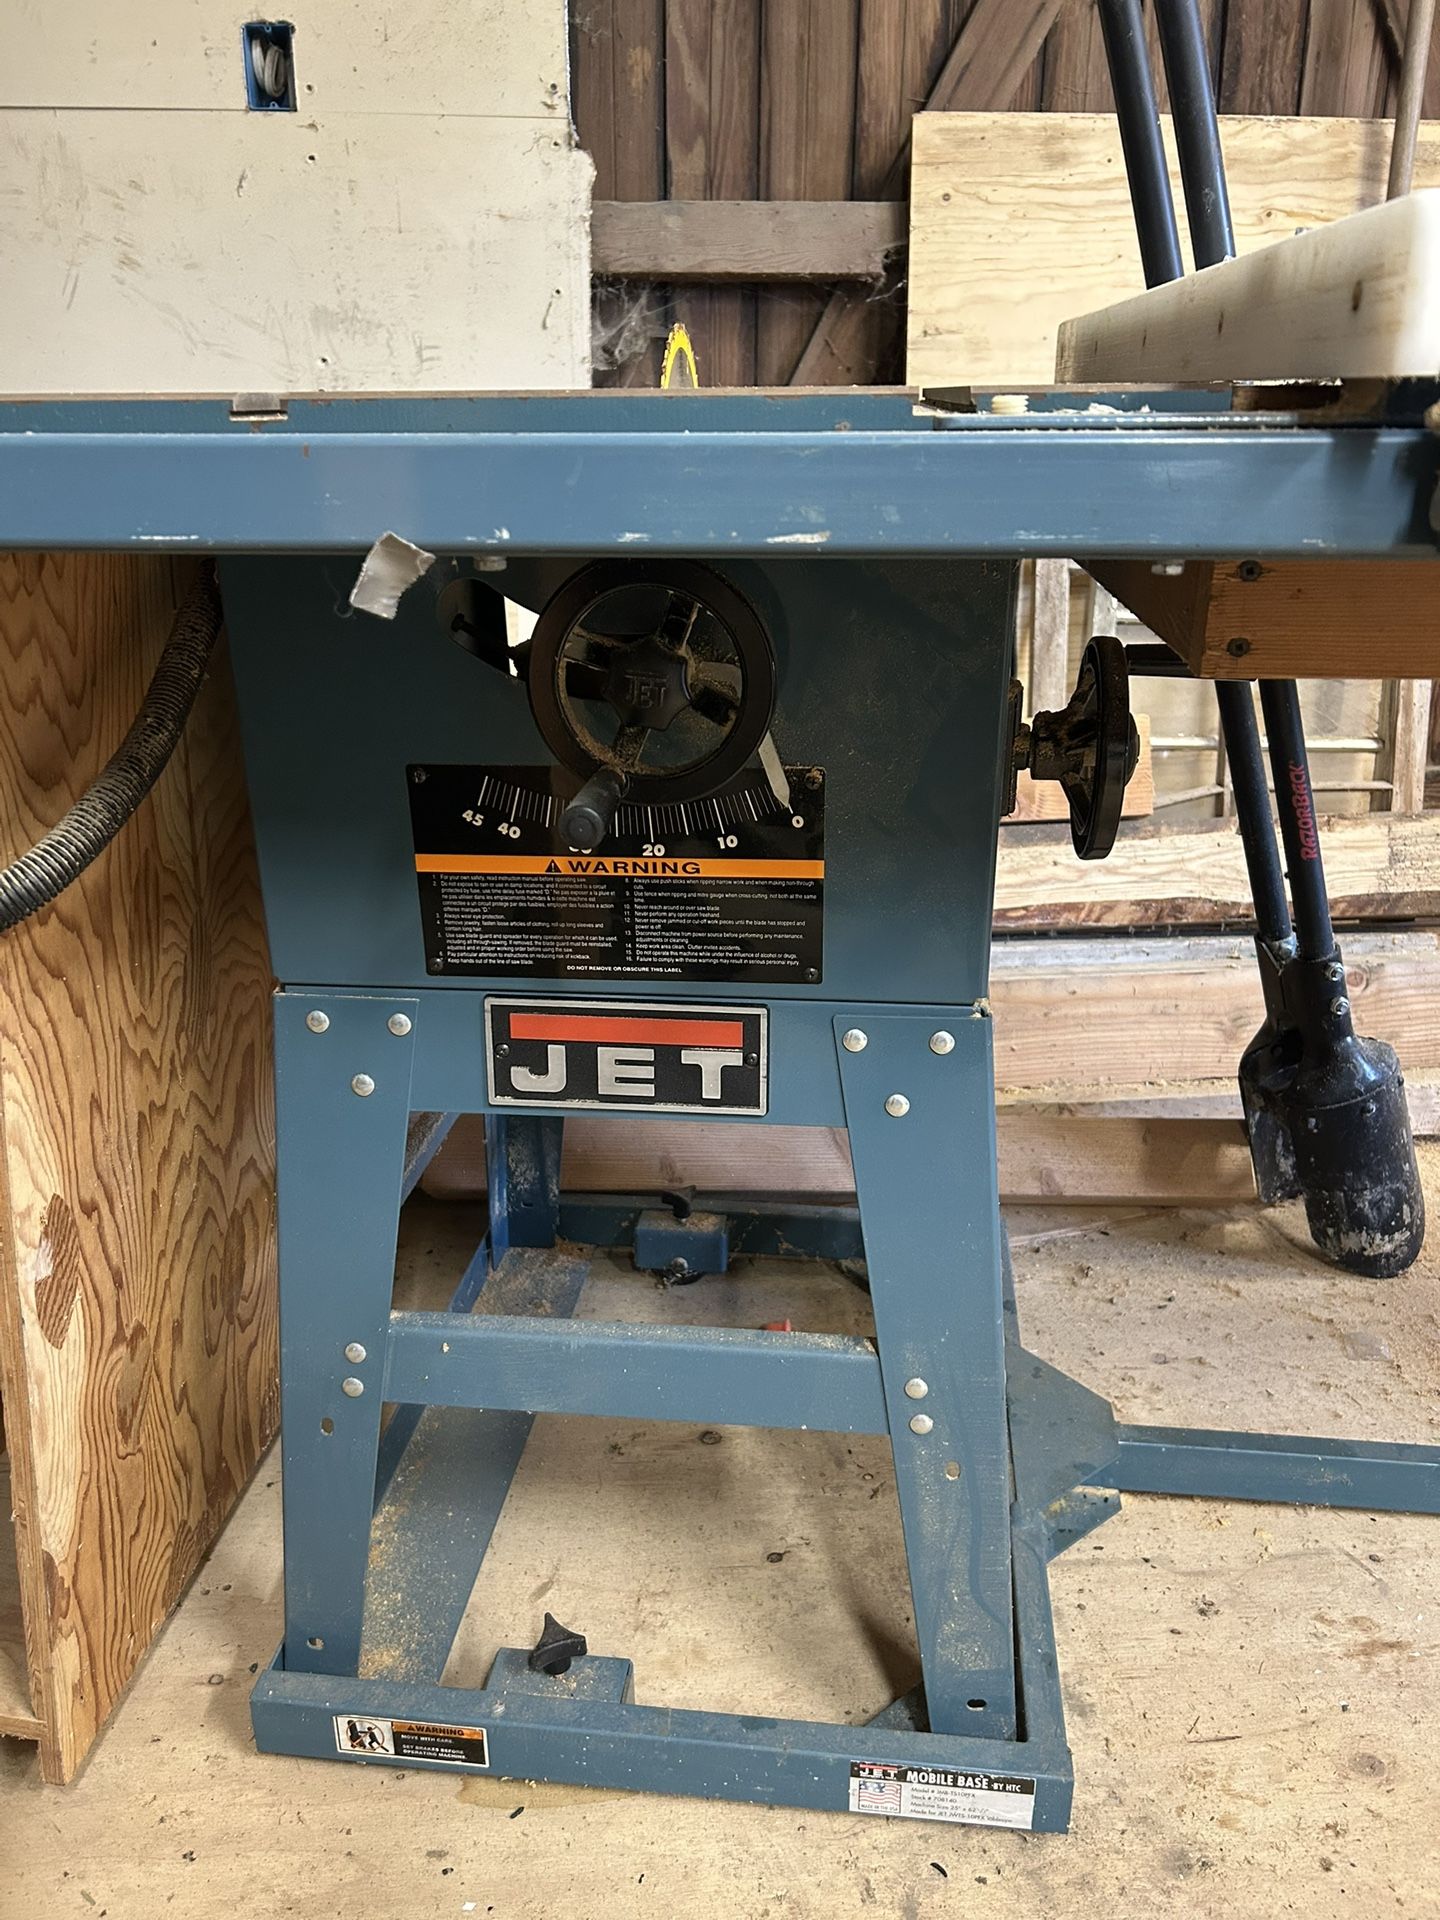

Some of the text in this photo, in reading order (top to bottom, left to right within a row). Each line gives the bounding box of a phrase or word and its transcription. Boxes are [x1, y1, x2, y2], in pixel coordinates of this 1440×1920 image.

[462, 809, 484, 826] 45
[791, 815, 804, 828] 0
[497, 822, 520, 838] 40
[717, 835, 738, 849] 10
[642, 844, 665, 856] 20
[568, 860, 700, 874] WARNING
[510, 1044, 743, 1099] JET
[416, 1725, 464, 1737] WARNING
[403, 1748, 437, 1757] OPERATING
[860, 1767, 898, 1781] JET
[906, 1770, 988, 1791] MOBILE BASE
[1006, 1784, 1021, 1793] HTC
